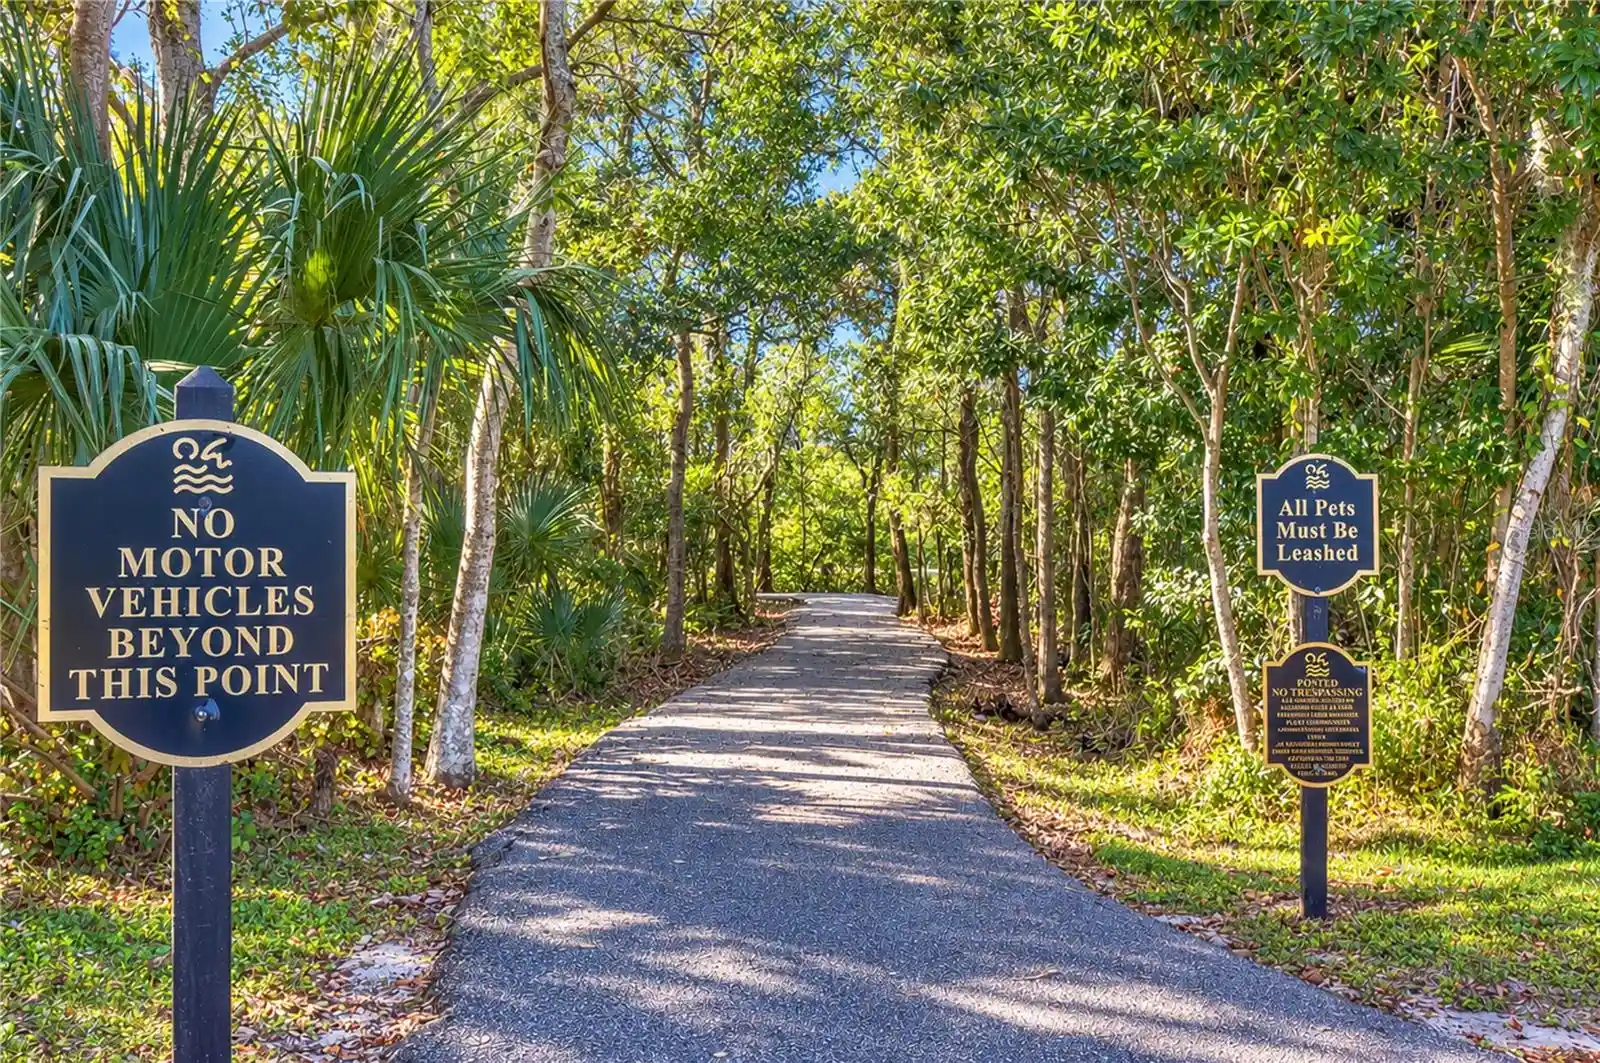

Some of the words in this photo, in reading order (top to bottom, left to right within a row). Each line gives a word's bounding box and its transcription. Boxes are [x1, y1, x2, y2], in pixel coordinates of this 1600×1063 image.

[171, 507, 235, 539] NO
[1278, 499, 1308, 517] All
[1315, 499, 1356, 517] Pets
[1276, 521, 1327, 540] Must
[1333, 521, 1359, 539] Be
[117, 546, 287, 578] MOTOR
[1276, 543, 1359, 562] Leashed
[85, 585, 315, 618] VEHICLES
[107, 625, 295, 659] BEYOND
[68, 666, 178, 701] THIS
[193, 662, 330, 698] POINT
[1272, 688, 1288, 697] NO
[1289, 687, 1363, 697] TRESPASSING
